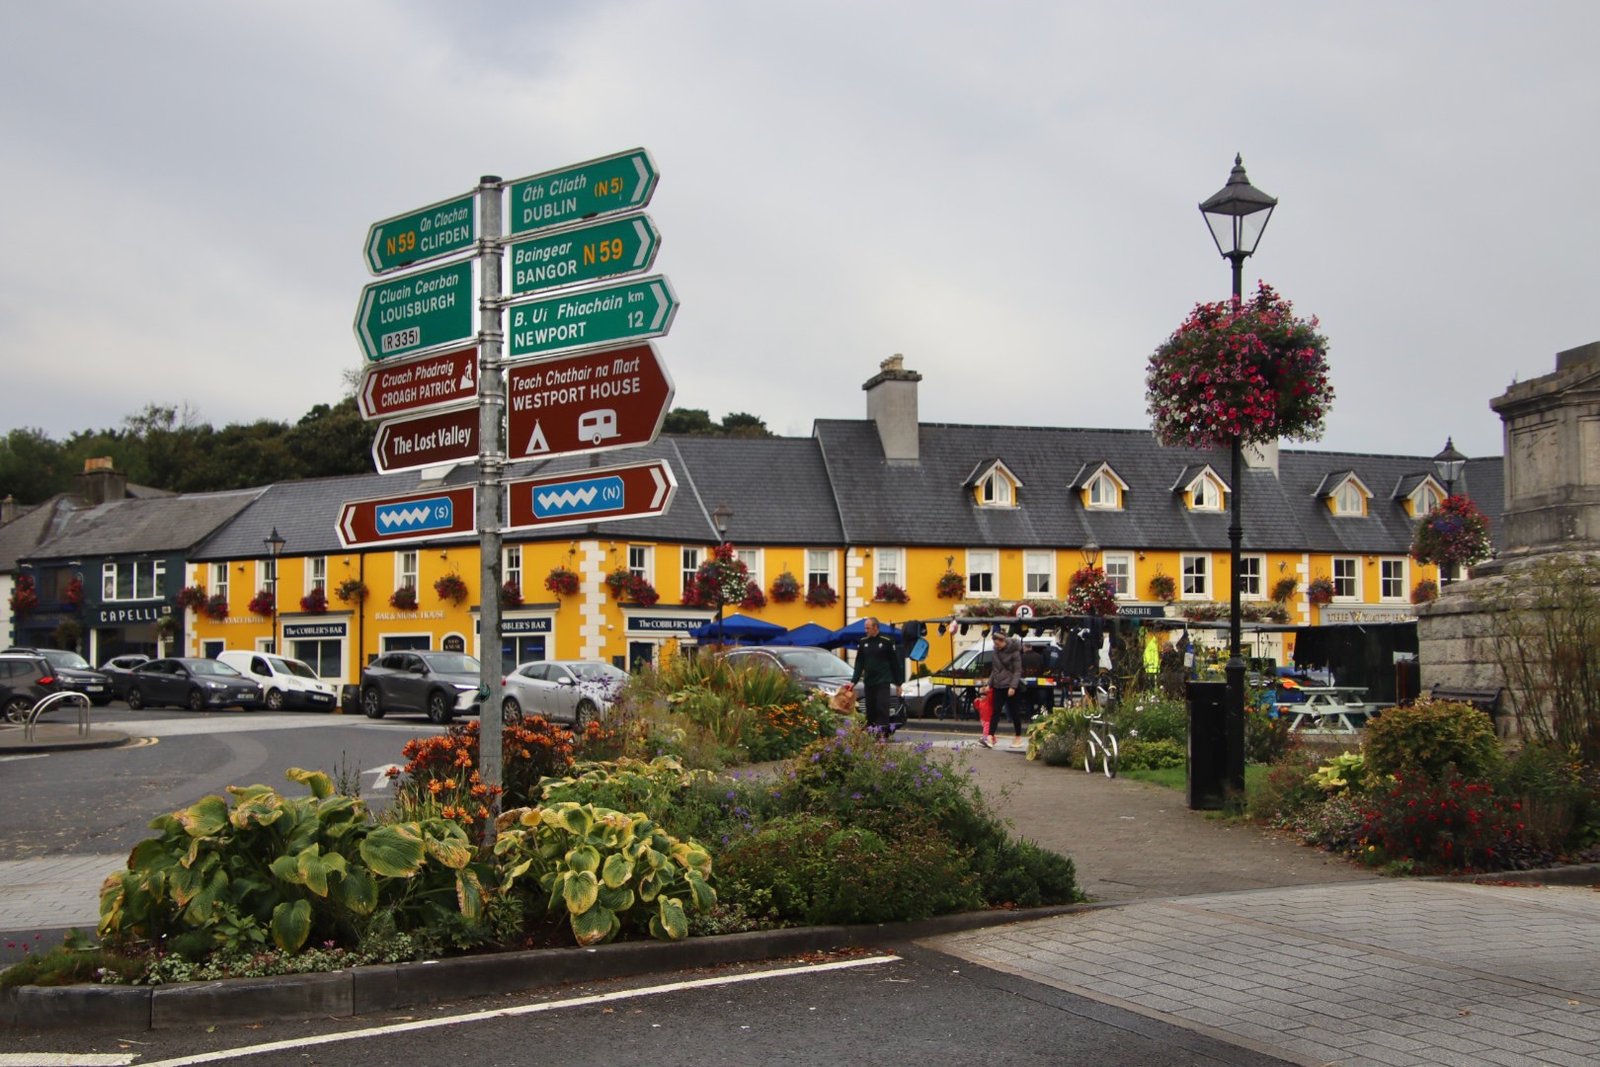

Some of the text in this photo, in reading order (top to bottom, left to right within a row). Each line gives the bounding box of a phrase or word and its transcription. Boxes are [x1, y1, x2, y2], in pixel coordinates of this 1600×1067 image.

[549, 174, 587, 196] Cliath
[420, 208, 468, 232] An Clochán
[523, 197, 577, 224] DUBLIN
[420, 225, 469, 251] CLIFDEN
[515, 242, 573, 265] Baingear
[516, 259, 577, 285] BANGOR
[380, 273, 459, 305] Cluain Cearbán
[627, 291, 645, 304] km
[380, 292, 456, 325] LOUISBURGH
[514, 295, 623, 328] B. Uí Fhiacháin
[627, 310, 644, 329] 12
[514, 321, 587, 348] NEWPORT
[381, 368, 413, 389] Cruach
[512, 356, 640, 391] Teach Chathair na Mart
[381, 378, 457, 408] CROAGH PATRICK
[512, 377, 641, 412] WESTPORT HOUSE
[393, 425, 472, 456] The Lost Valley
[602, 485, 621, 502] (N)
[434, 505, 449, 521] (S)
[100, 608, 158, 622] CAPELLI
[530, 620, 546, 630] BAR
[638, 619, 651, 628] The
[329, 626, 343, 634] BAR
